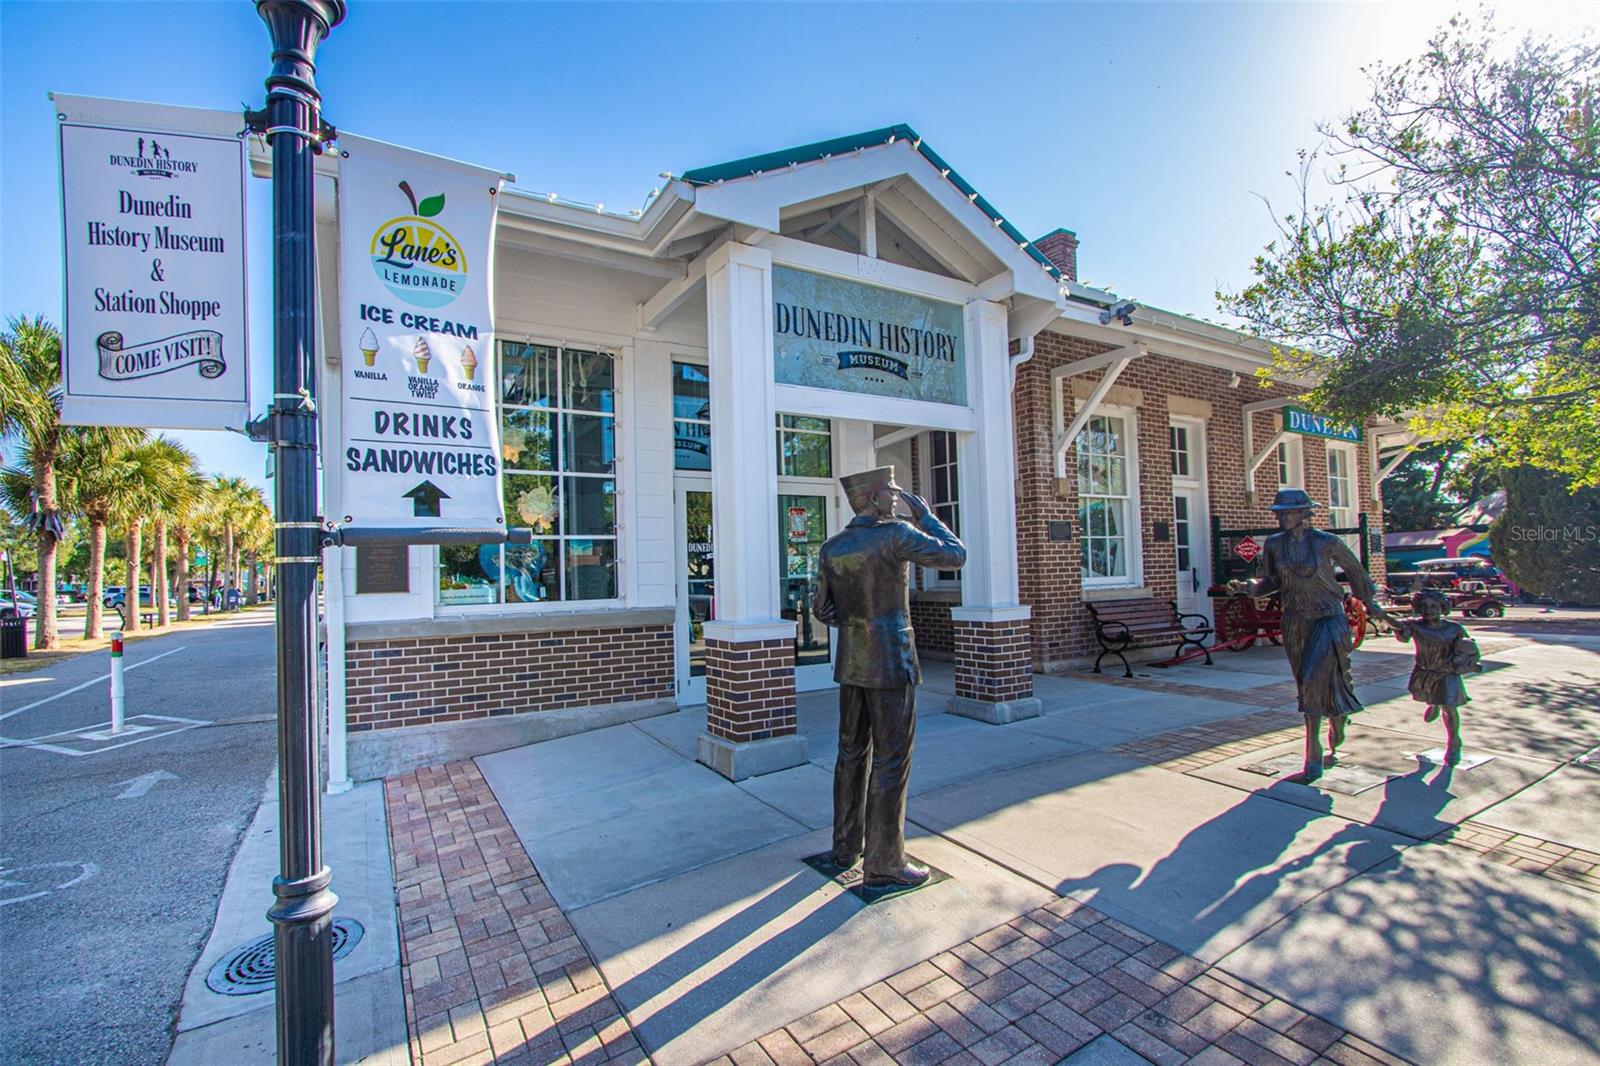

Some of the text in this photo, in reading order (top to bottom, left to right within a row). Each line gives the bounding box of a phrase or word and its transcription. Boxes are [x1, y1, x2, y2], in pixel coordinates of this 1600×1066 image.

[110, 155, 154, 169] DUNEDIN
[156, 159, 198, 173] HISTORY
[119, 190, 192, 219] Dunedin
[88, 222, 225, 253] History Museum
[376, 228, 457, 269] Lane's
[150, 258, 165, 282] &
[384, 269, 456, 292] LEMONADE
[95, 287, 221, 321] Station Shoppe
[360, 304, 478, 340] ICE CREAM
[775, 302, 958, 362] DUNEDIN HISTORY
[115, 336, 211, 375] COME VISIT!
[848, 354, 899, 372] MUSEUM
[354, 370, 388, 381] VANILLA
[408, 376, 439, 387] VANILLA
[408, 383, 438, 393] ORANGE
[457, 382, 486, 393] ORANGE
[411, 390, 436, 400] TWIST
[375, 410, 473, 440] DRINKS
[346, 447, 497, 477] SANDWICHES
